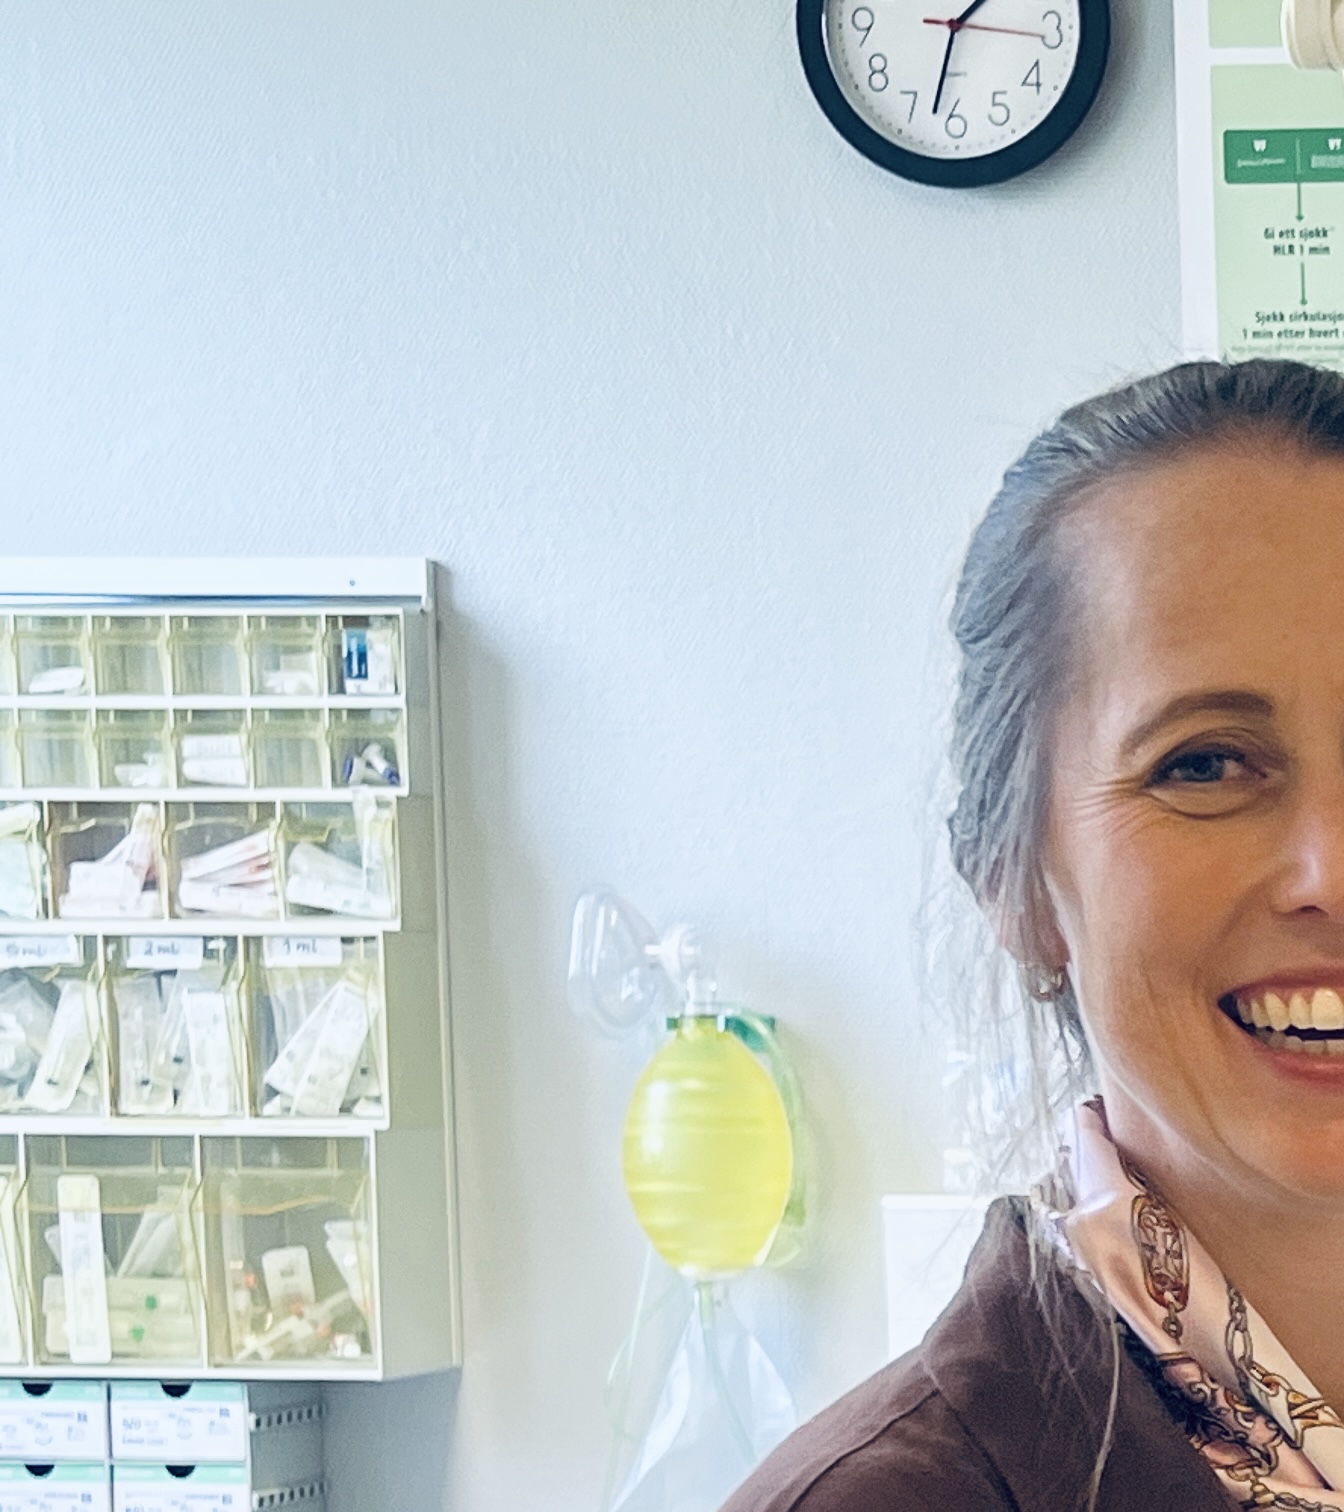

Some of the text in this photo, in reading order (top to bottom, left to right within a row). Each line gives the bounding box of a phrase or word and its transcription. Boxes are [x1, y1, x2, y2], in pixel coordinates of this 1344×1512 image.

[850, 6, 875, 48] 9
[1041, 9, 1064, 50] 3
[867, 53, 890, 93] 8
[1020, 59, 1043, 95] 4
[899, 90, 918, 124] 7
[944, 98, 968, 139] 6
[988, 90, 1011, 127] 5
